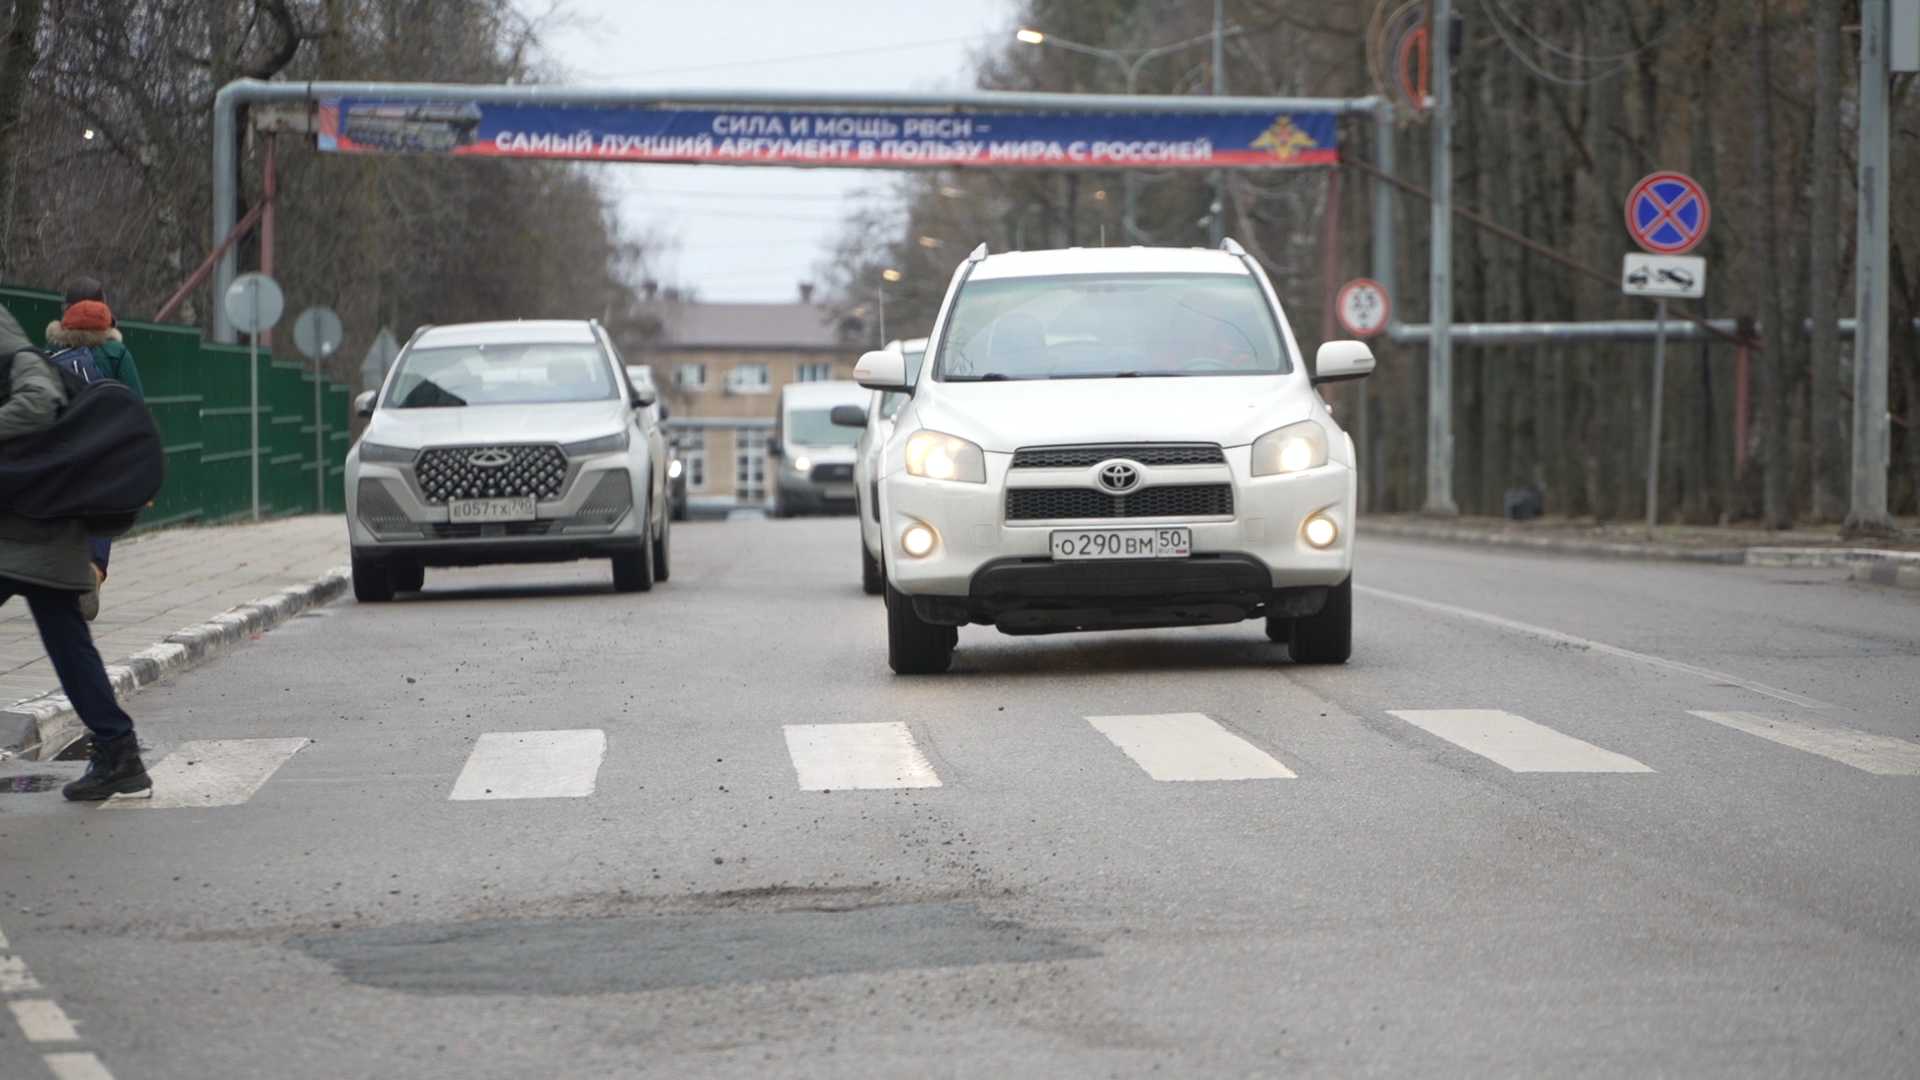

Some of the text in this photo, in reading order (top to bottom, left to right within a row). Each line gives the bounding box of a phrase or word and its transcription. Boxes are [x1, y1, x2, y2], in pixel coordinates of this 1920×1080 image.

[713, 114, 785, 136] СИЛА
[790, 117, 809, 137] И
[815, 117, 898, 141] МОЩЬ
[903, 118, 972, 138] РВСН
[495, 129, 1213, 161] САМЫЙ ЛУЧШИЙ АРГУМЕНТ В ПОЛЬЗУ МИРА С РОССИЕЙ
[1159, 531, 1182, 547] 50
